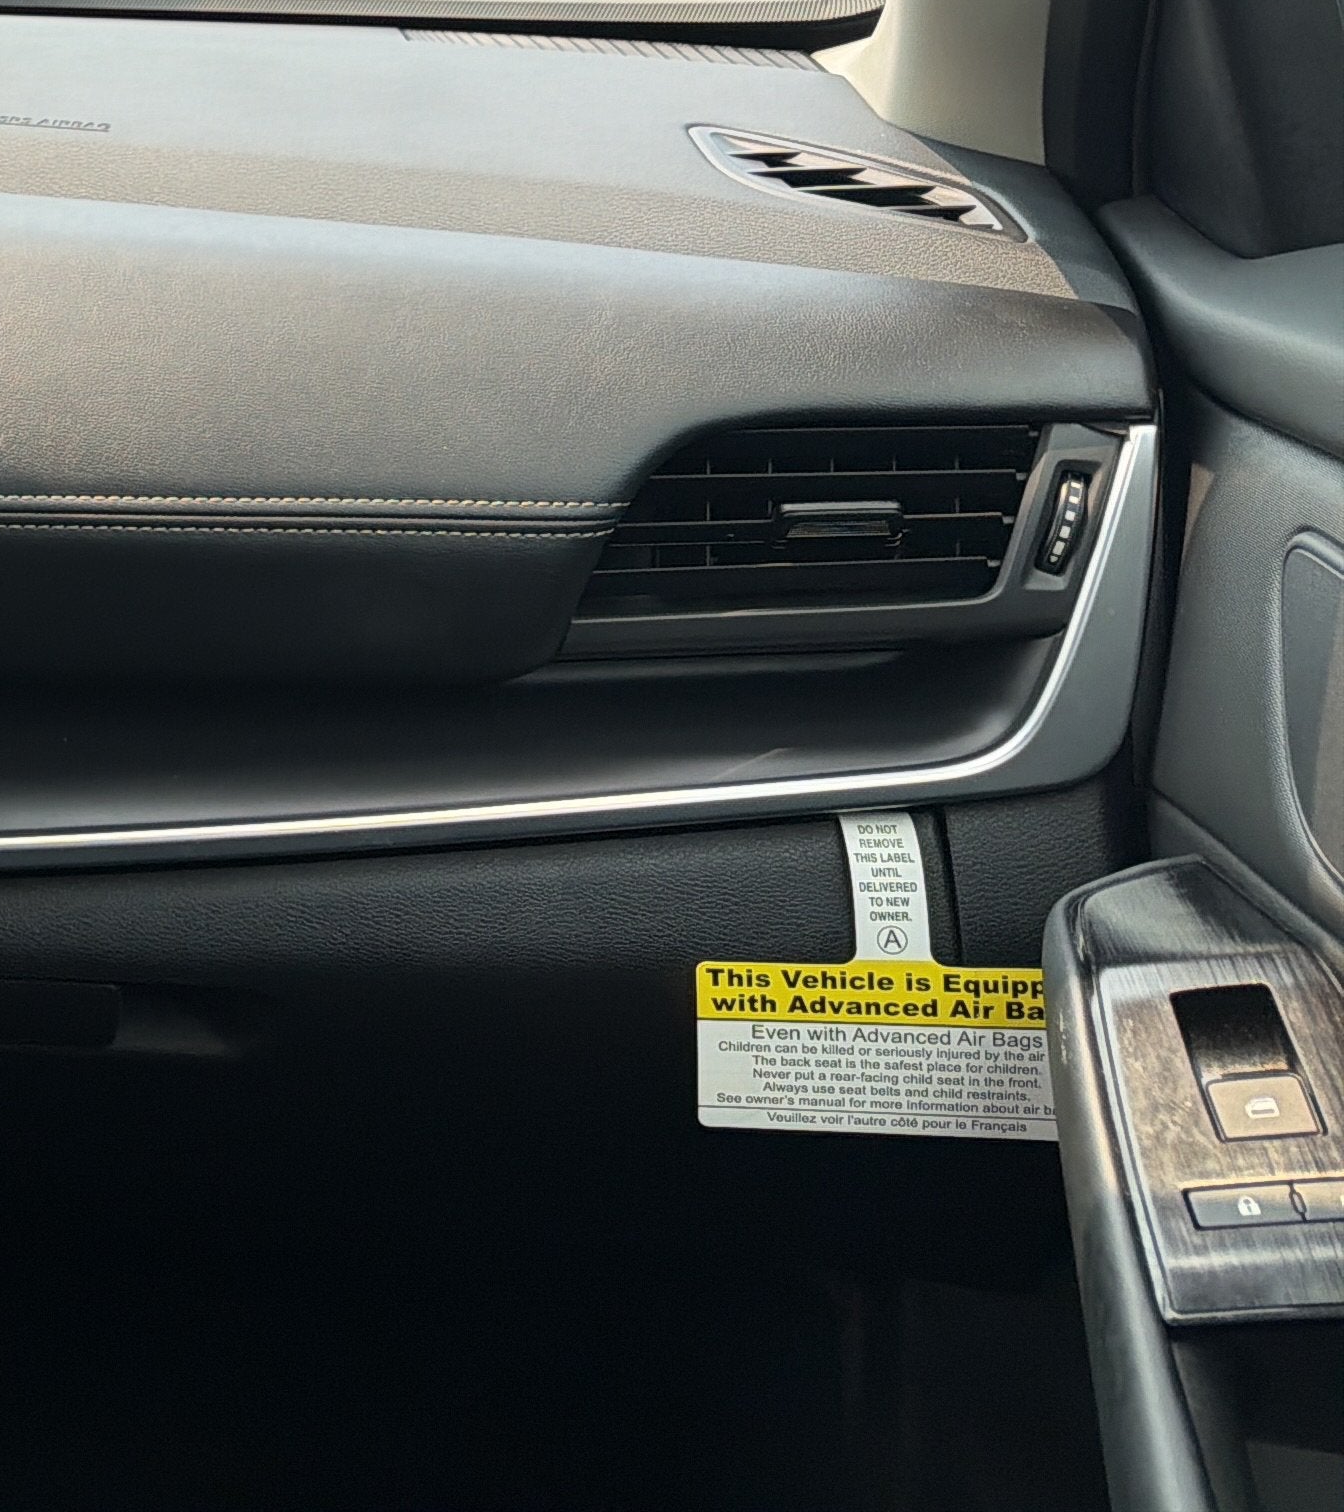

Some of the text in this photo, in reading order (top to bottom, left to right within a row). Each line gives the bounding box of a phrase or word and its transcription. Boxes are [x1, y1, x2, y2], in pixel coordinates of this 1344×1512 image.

[857, 824, 898, 835] DO NOT
[859, 838, 905, 849] REMOVE
[853, 852, 916, 864] THIS LABEL
[871, 867, 903, 878] UNTIL
[858, 881, 918, 893] DELIVERED
[868, 896, 910, 907] TO NEW
[869, 911, 913, 922] OWNER.
[883, 929, 903, 949] A
[706, 967, 771, 988] This
[781, 969, 894, 991] Vehicle
[905, 972, 932, 992] is
[711, 993, 777, 1013] with
[787, 995, 938, 1018] Advanced
[949, 999, 995, 1020] Air
[751, 1023, 1043, 1052] Even with Advanced Air Bags
[718, 1040, 1046, 1062] Children can be killed or seriously injured by the air
[752, 1054, 1042, 1076] The back seat is the safest place for children.
[752, 1067, 1042, 1089] Never put a rear-facing child seat in the front.
[762, 1081, 1031, 1102] Always use seat belts and child restraints.
[716, 1092, 1041, 1115] See owner's manual for more information about air
[766, 1111, 1028, 1133] Veuillez voir l'autre côté pour le Français
